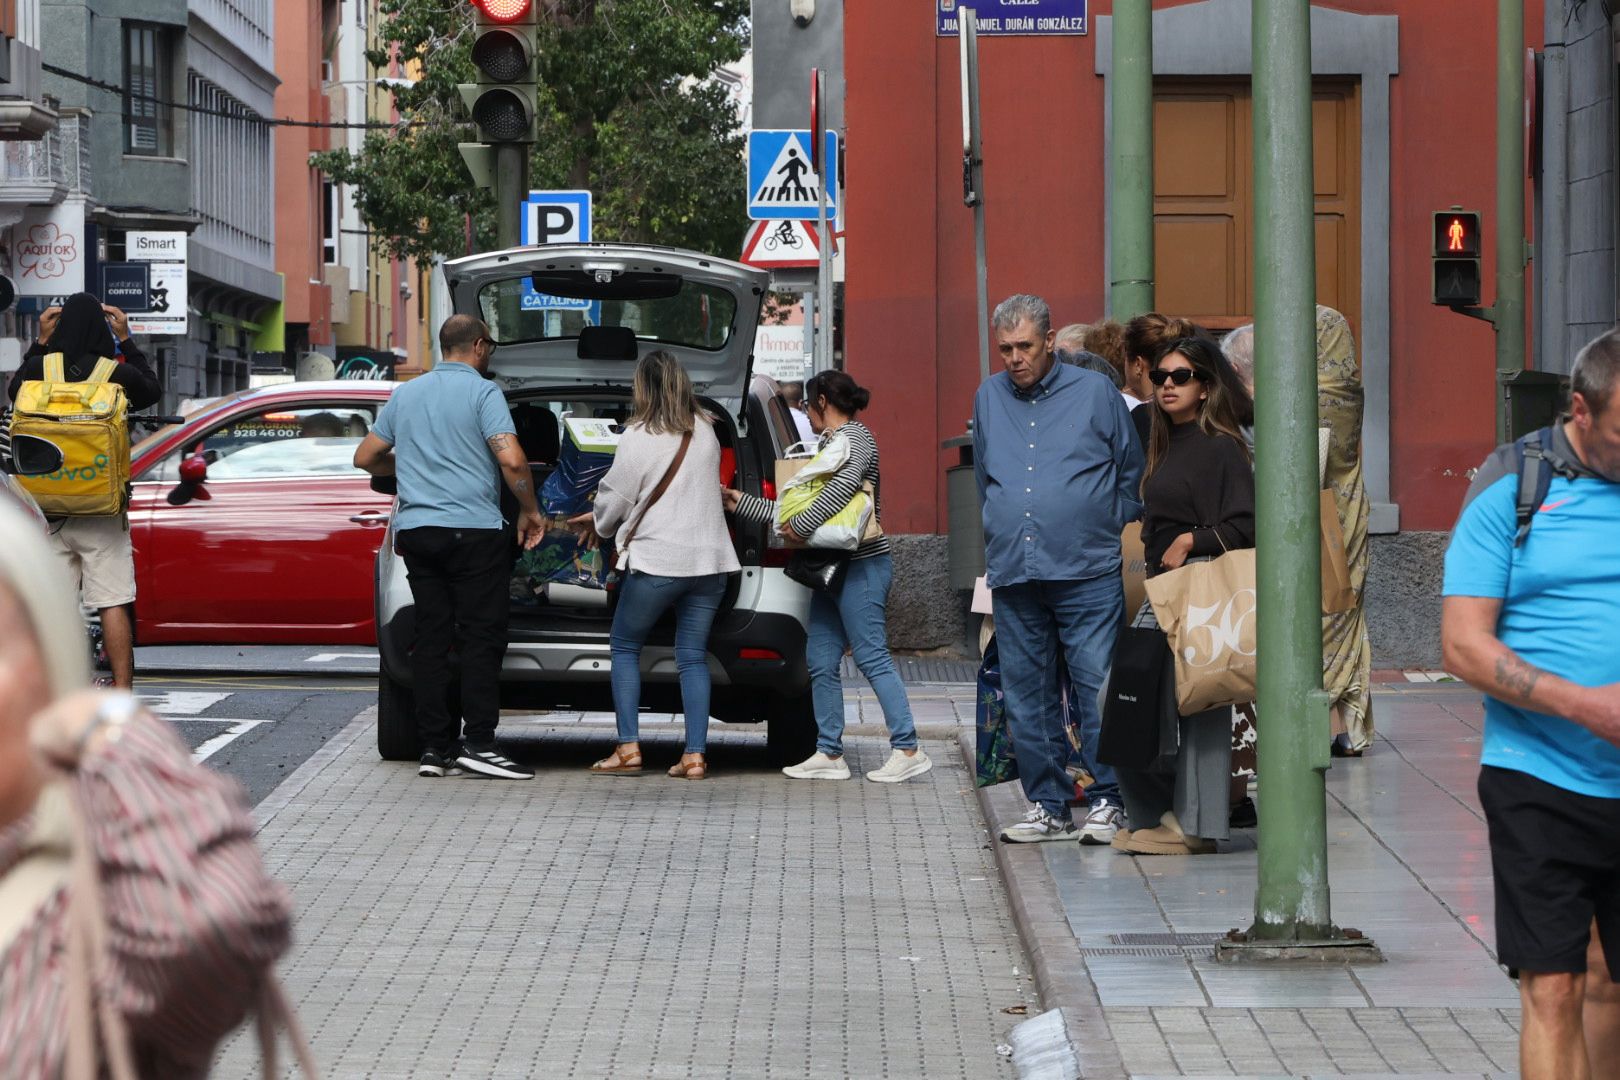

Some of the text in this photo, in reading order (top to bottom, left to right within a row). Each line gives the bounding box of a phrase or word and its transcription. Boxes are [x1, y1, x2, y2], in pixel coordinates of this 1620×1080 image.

[975, 18, 1002, 31] ANUEL
[1005, 16, 1034, 31] DURÁN
[1037, 16, 1083, 30] GONZÁLEZ
[537, 205, 574, 246] P
[24, 242, 72, 255] AQUÍ OK
[136, 236, 177, 249] iSmart
[234, 429, 257, 438] 928
[258, 429, 276, 437] 46
[277, 429, 295, 437] 00
